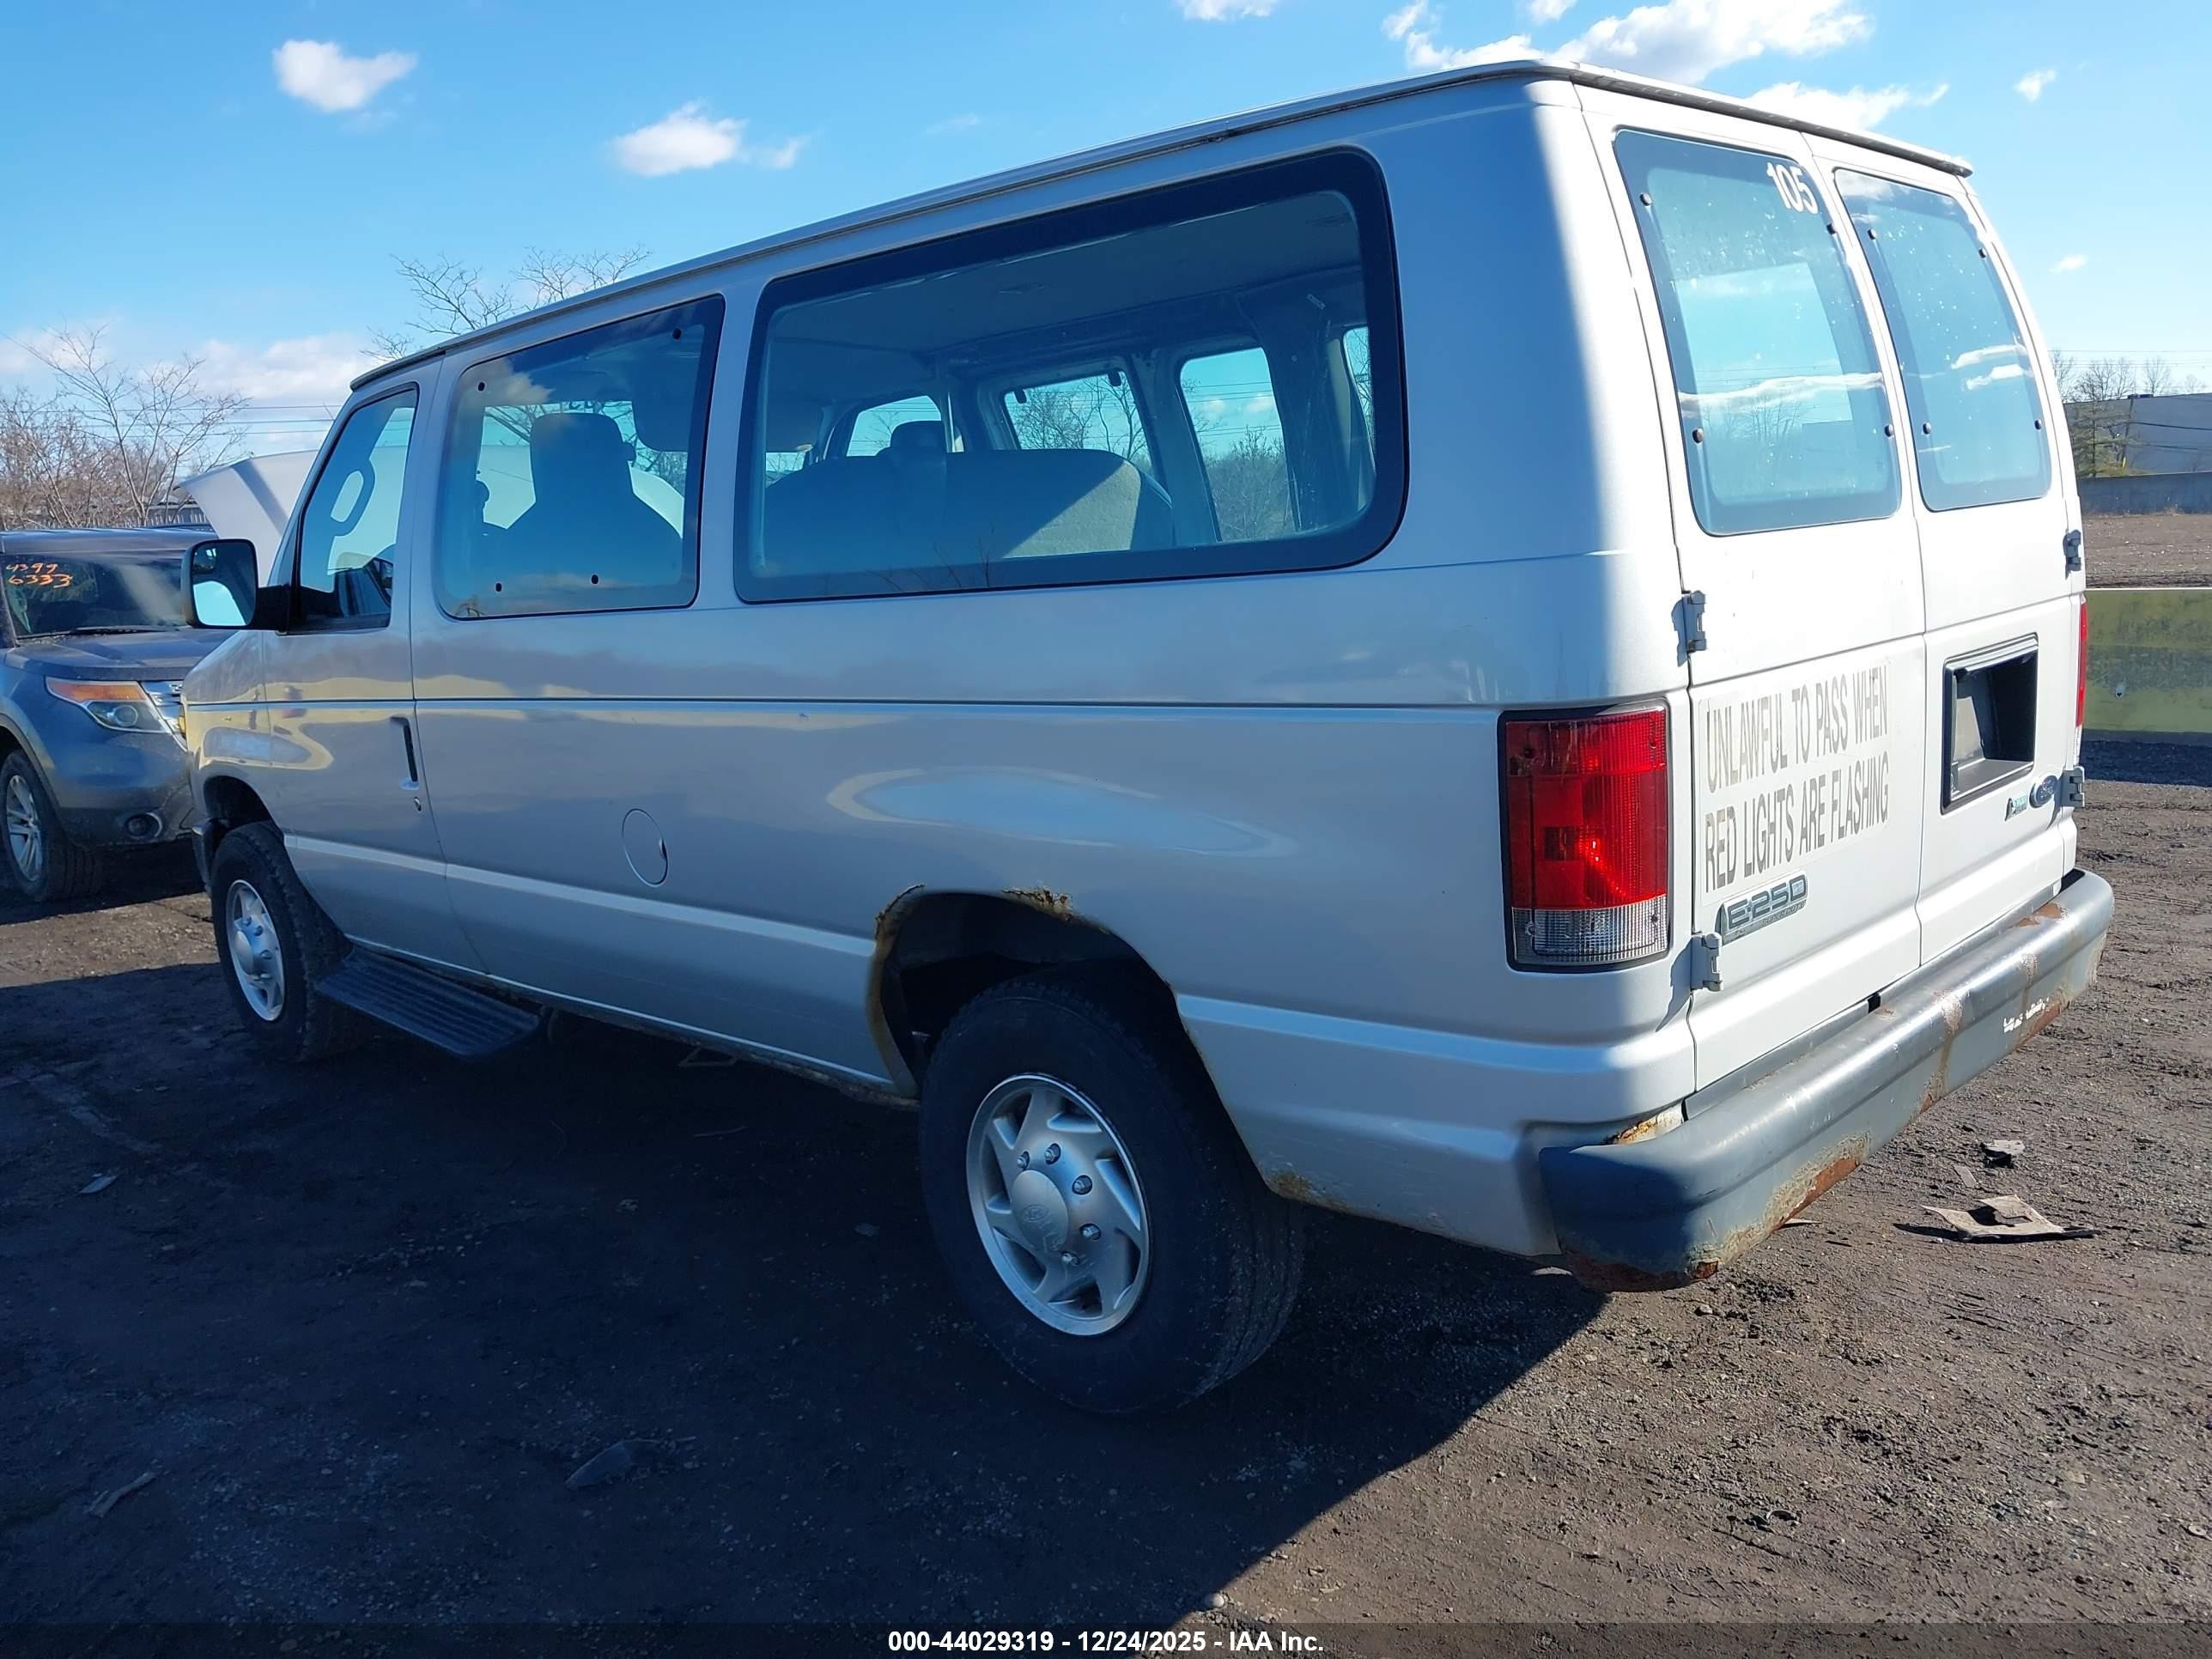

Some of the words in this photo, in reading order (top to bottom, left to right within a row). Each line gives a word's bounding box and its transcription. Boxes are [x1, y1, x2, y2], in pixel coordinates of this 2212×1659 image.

[1766, 161, 1819, 215] 105
[9, 574, 74, 589] 6333
[1706, 693, 1788, 793] UNLAWFUL
[1792, 684, 1811, 764] TO
[1815, 674, 1849, 757] PASS
[1852, 665, 1888, 745] WHEN
[1705, 805, 1737, 893] RED
[1744, 784, 1795, 878] LIGHTS
[1800, 775, 1826, 856] ARE
[1831, 751, 1889, 843] FLASHING
